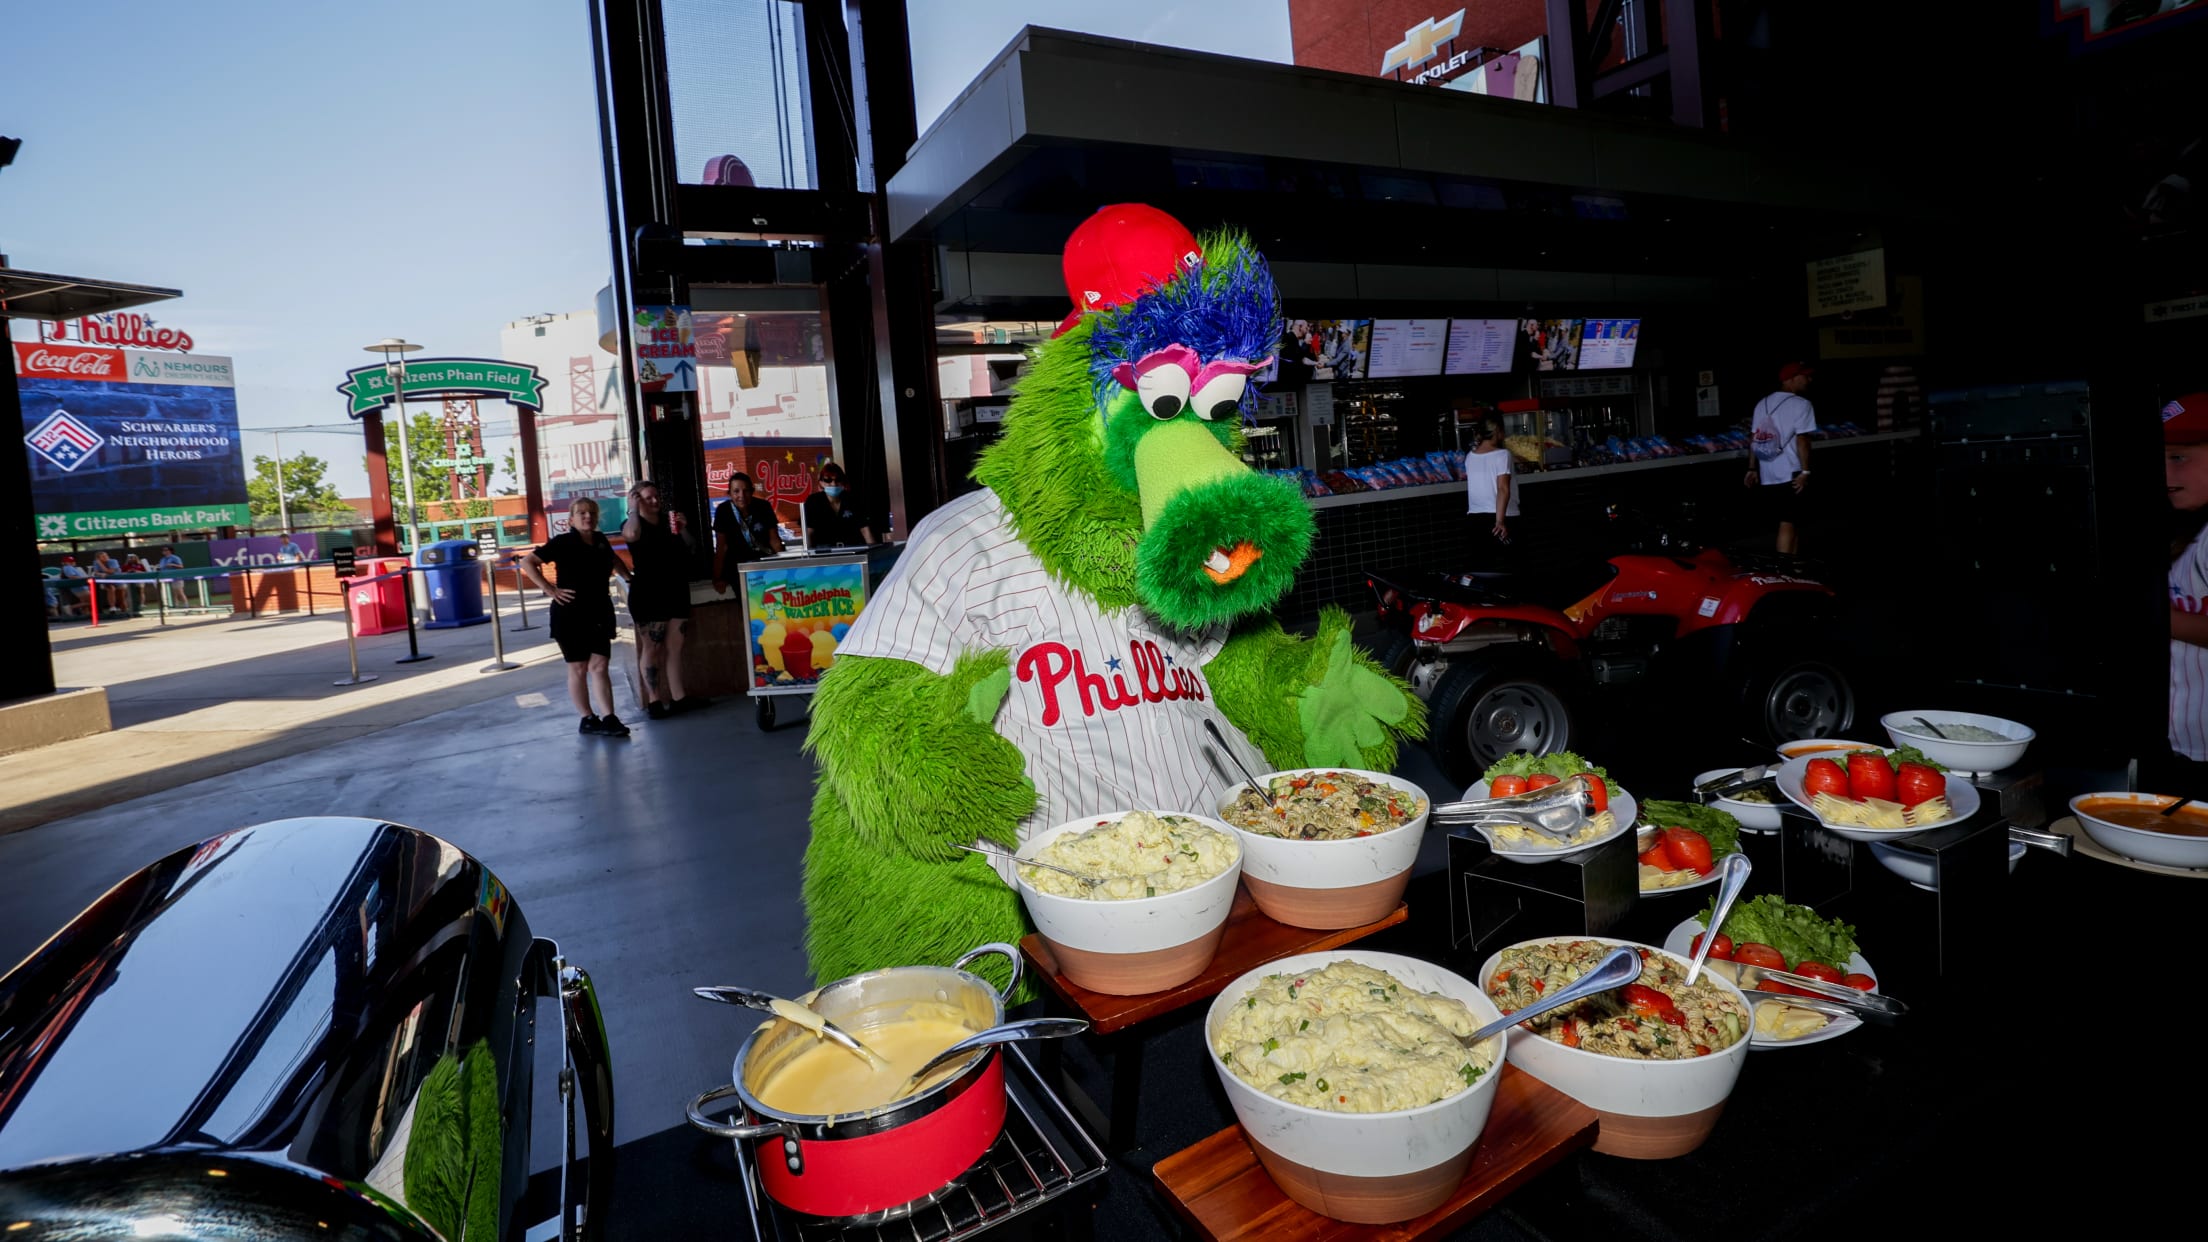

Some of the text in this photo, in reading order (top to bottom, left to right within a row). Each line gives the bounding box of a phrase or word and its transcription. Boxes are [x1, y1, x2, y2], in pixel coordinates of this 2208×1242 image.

[651, 328, 679, 342] ICE
[638, 343, 696, 358] CREAM
[26, 349, 113, 376] Coca-Cola
[163, 361, 229, 374] NEMOURS
[385, 369, 521, 386] Cizens Phan Field
[110, 434, 229, 448] NEIGHBORHOOD
[145, 449, 202, 461] HEROES
[756, 460, 812, 512] Yard
[73, 508, 231, 532] Citizens Bank Park
[214, 547, 315, 567] xfiny
[781, 588, 852, 607] Philadelphia
[783, 597, 855, 619] WATER ICE
[1015, 640, 1205, 727] Phillies
